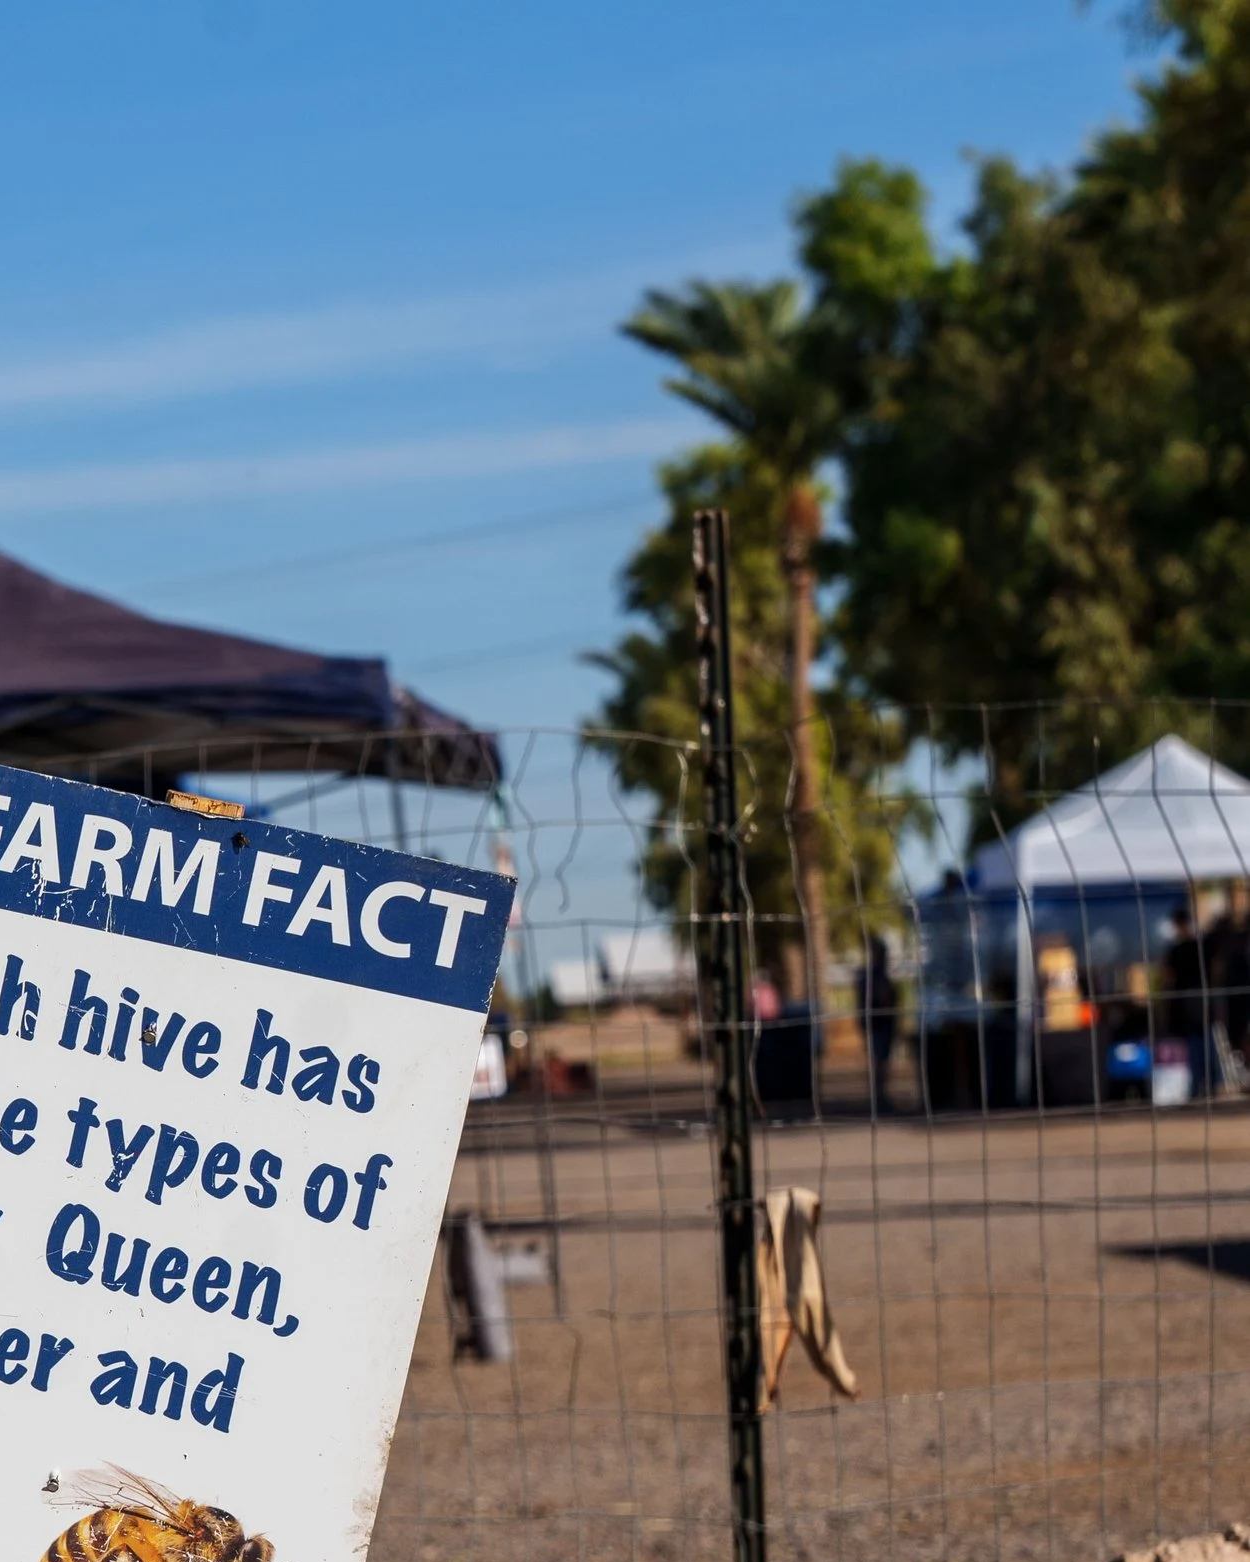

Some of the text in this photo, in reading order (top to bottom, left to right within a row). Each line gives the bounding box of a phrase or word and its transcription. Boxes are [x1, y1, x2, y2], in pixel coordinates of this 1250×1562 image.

[242, 851, 487, 969] FACT
[59, 969, 221, 1079] hive
[240, 1008, 380, 1114] has
[66, 1097, 283, 1208] types
[304, 1153, 393, 1231] of
[46, 1203, 299, 1338] Queen,
[90, 1349, 245, 1434] and
